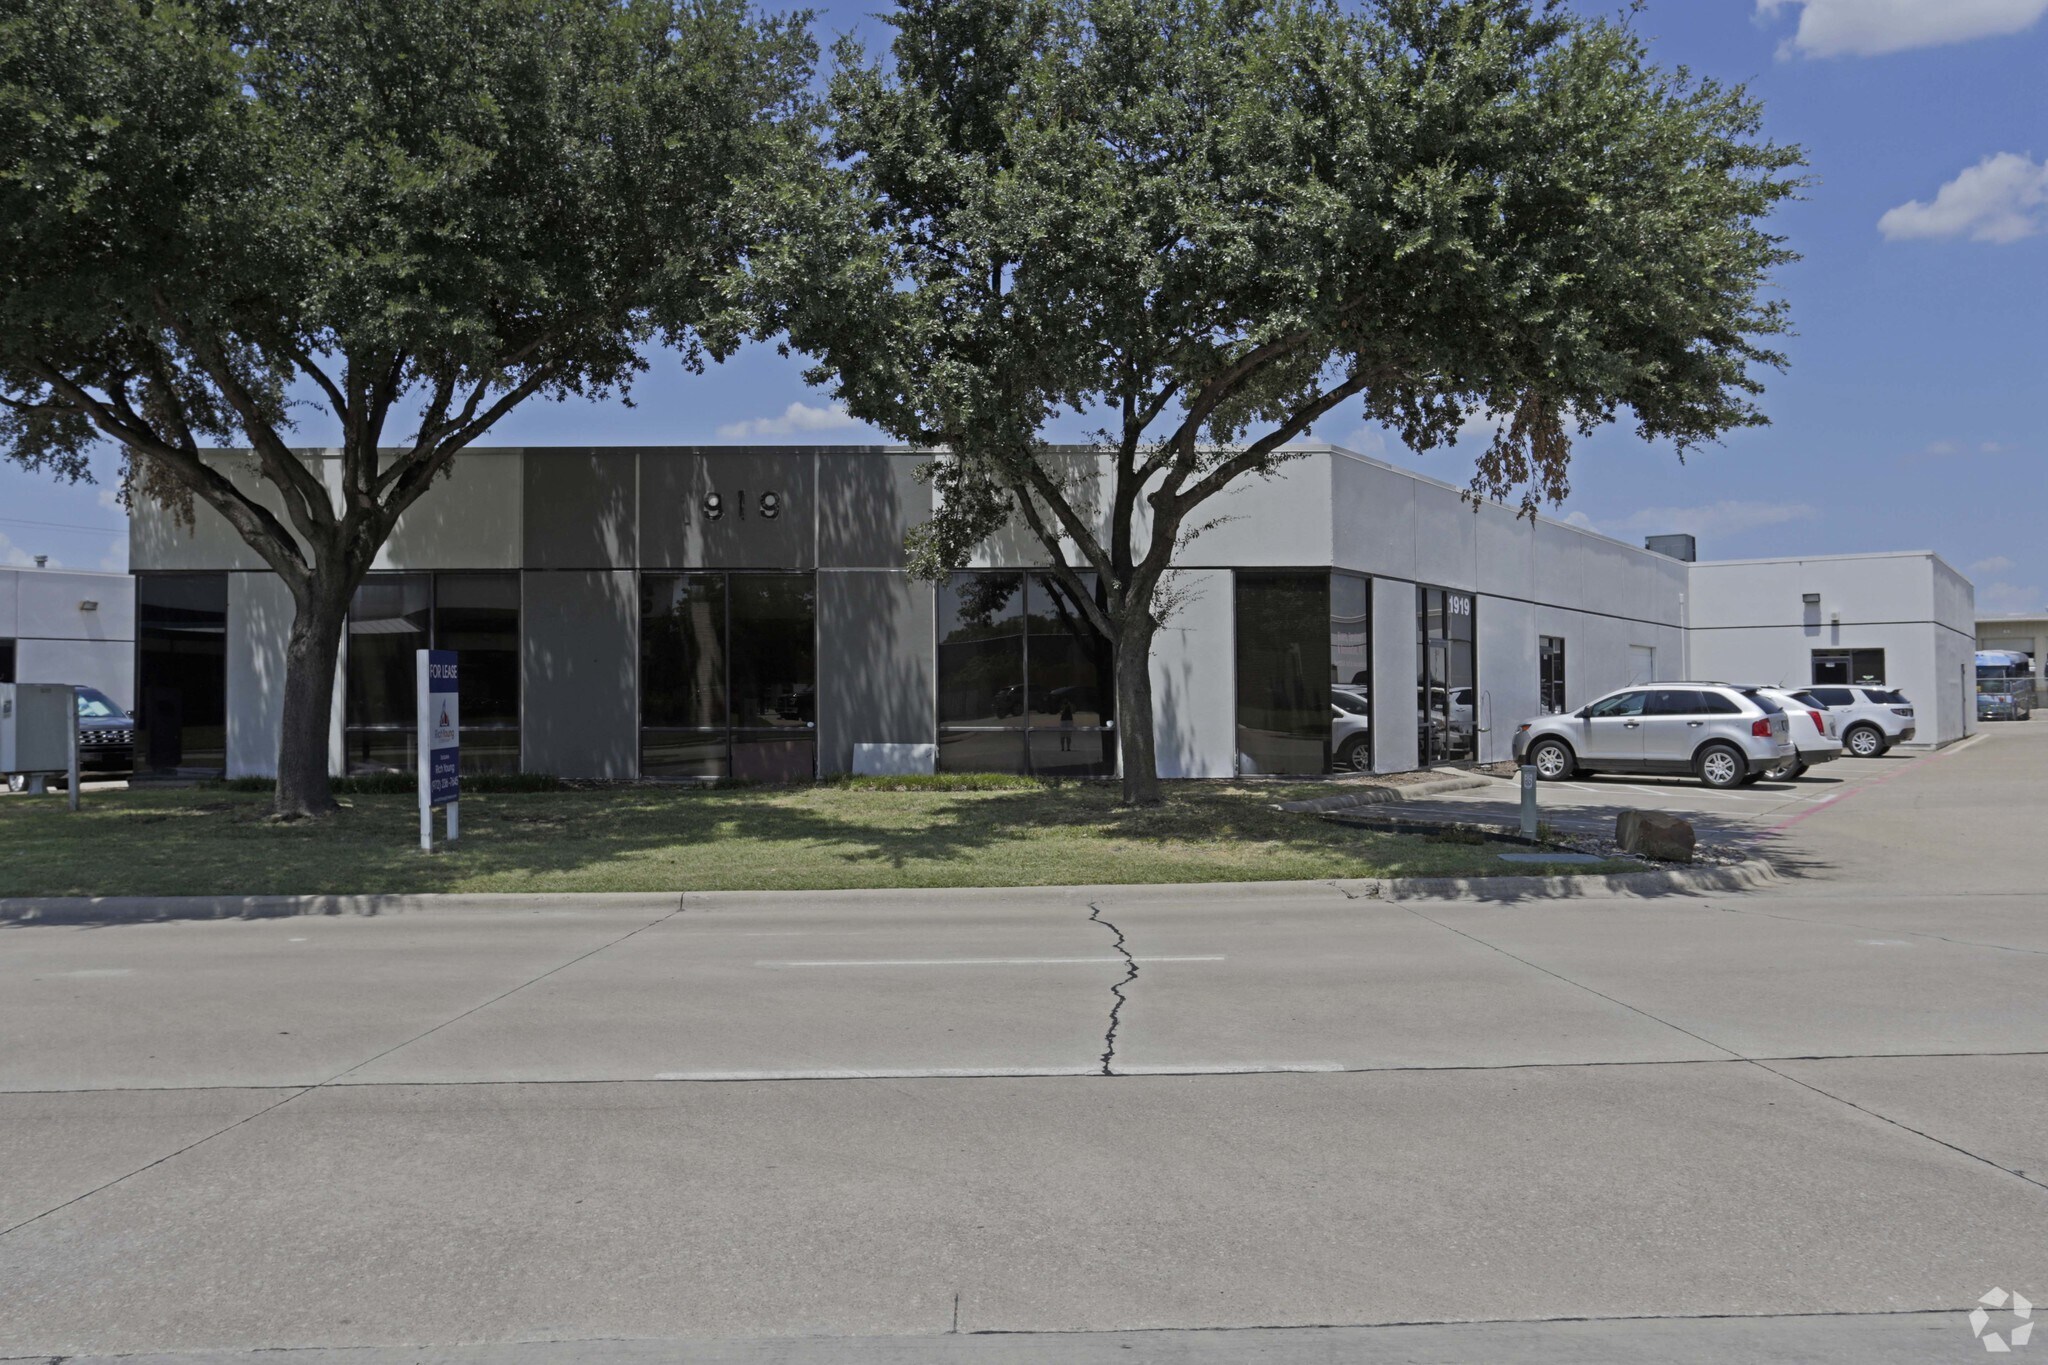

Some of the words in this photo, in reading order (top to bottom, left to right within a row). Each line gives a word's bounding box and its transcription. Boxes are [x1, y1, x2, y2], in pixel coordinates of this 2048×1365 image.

[1449, 595, 1470, 616] 1919
[430, 664, 441, 679] FOR
[442, 664, 458, 679] LEASE
